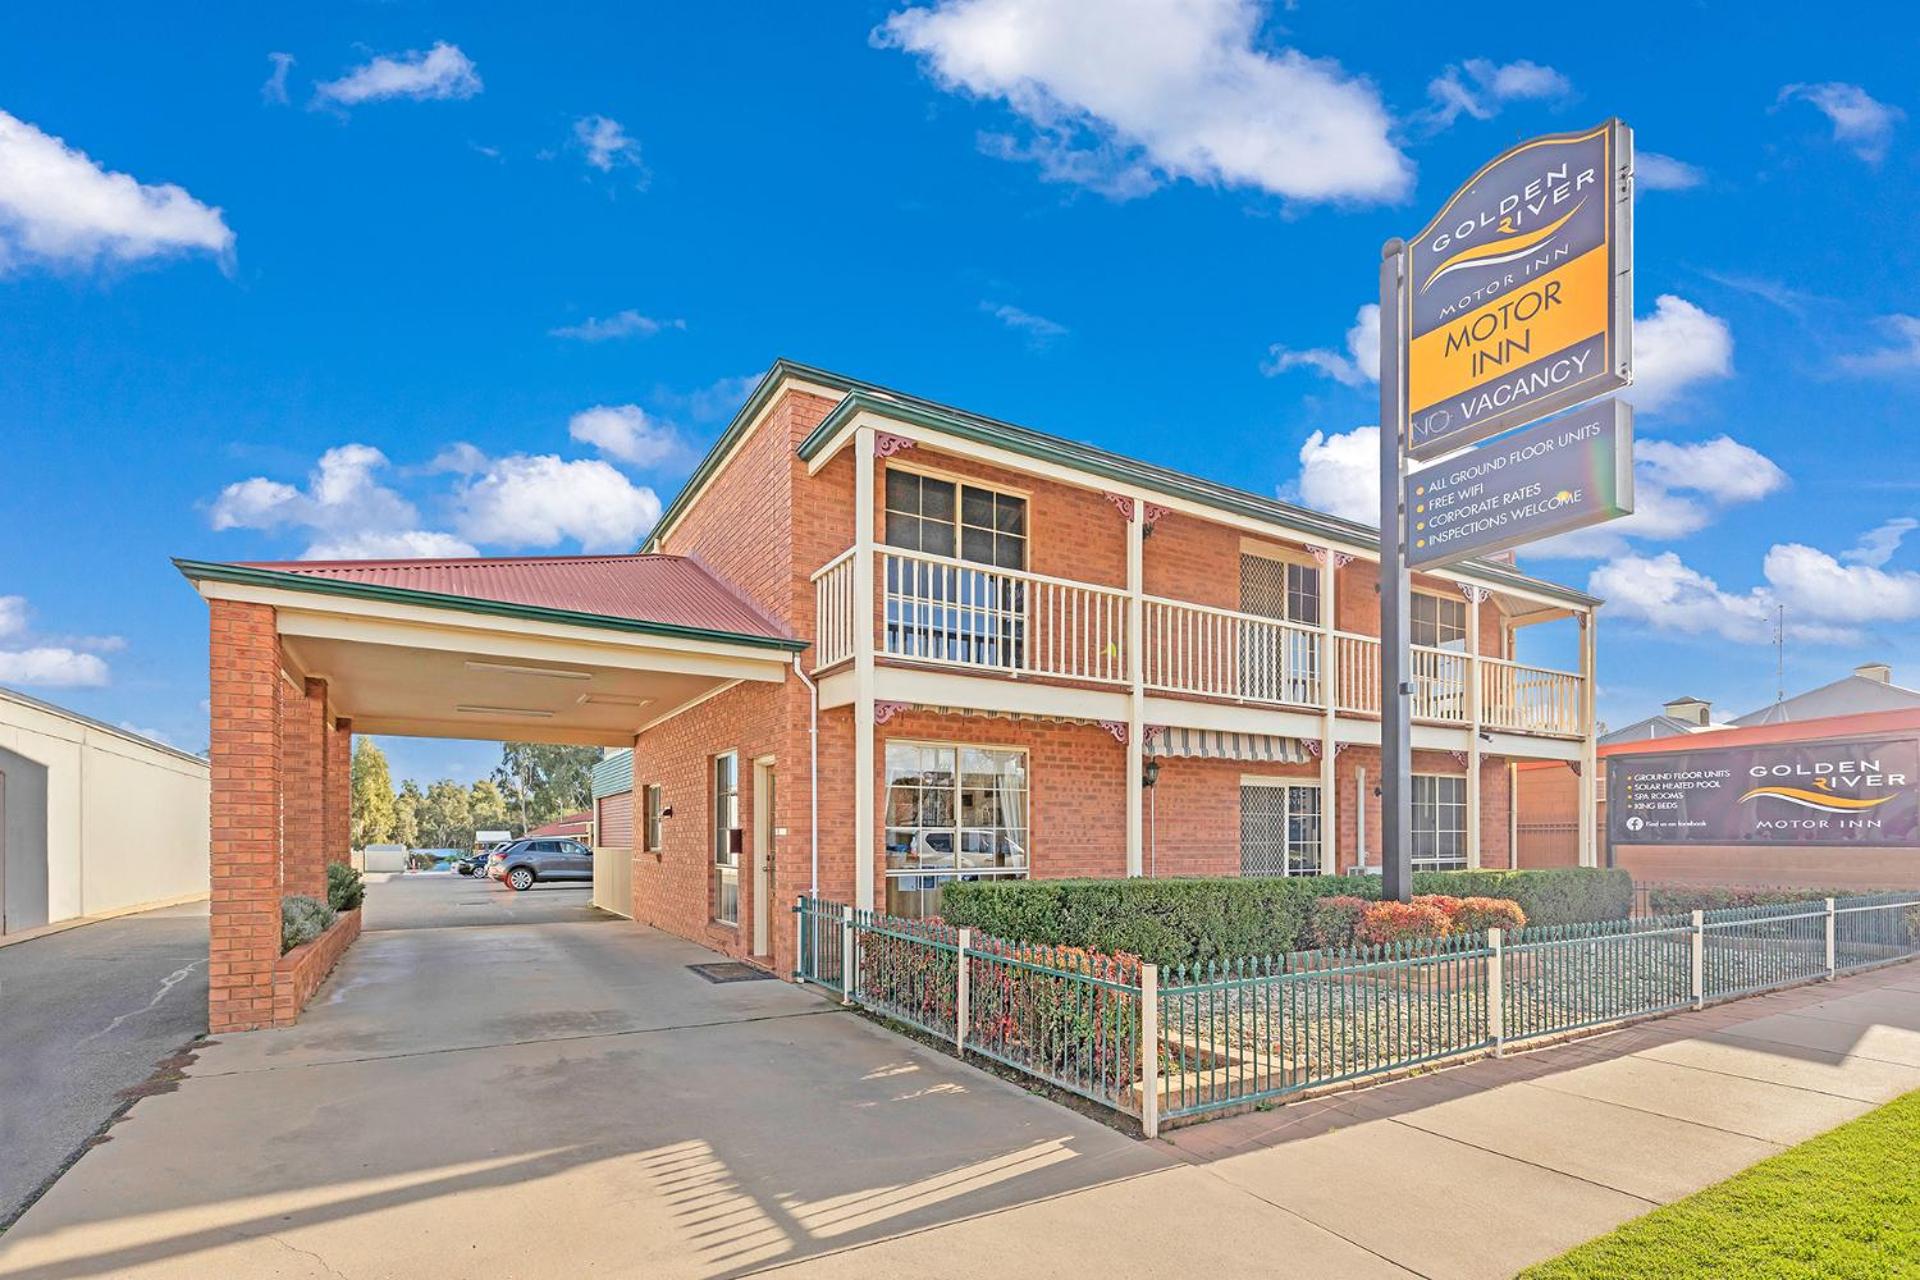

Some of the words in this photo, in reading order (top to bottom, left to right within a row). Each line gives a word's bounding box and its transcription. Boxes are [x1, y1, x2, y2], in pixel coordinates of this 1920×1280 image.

[1432, 163, 1567, 252] GOLDEN
[1496, 168, 1595, 234] RIVER
[1439, 274, 1514, 319] MOTOR
[1526, 244, 1569, 275] INN
[1445, 281, 1562, 357] MOTOR
[1473, 328, 1530, 377] INN
[1411, 410, 1450, 440] NO
[1461, 350, 1591, 418] VACANCY
[1428, 478, 1447, 493] ALL
[1450, 456, 1507, 485] GROUND
[1510, 439, 1554, 465] FLOOR
[1558, 422, 1601, 447] UNITS
[1429, 493, 1455, 511] FREE
[1458, 483, 1484, 500] WIFI
[1429, 497, 1500, 529] CORPORATE
[1503, 483, 1542, 505] RATES
[1429, 512, 1508, 546] INSPECTIONS
[1510, 489, 1582, 522] WELCOME
[1634, 772, 1672, 782] GROUND
[1673, 771, 1702, 780] FLOOR
[1704, 769, 1730, 778] UNITS
[1634, 783, 1661, 792] SOLAR
[1662, 781, 1694, 790] HEATED
[1696, 780, 1720, 788] POOL
[1749, 759, 1880, 778] GOLDEN
[1812, 773, 1906, 792] RIVER
[1634, 793, 1649, 801] SPA
[1651, 792, 1684, 800] ROOMS
[1657, 802, 1678, 810] BEDS
[1756, 819, 1830, 829] MOTOR
[1840, 819, 1881, 828] INN
